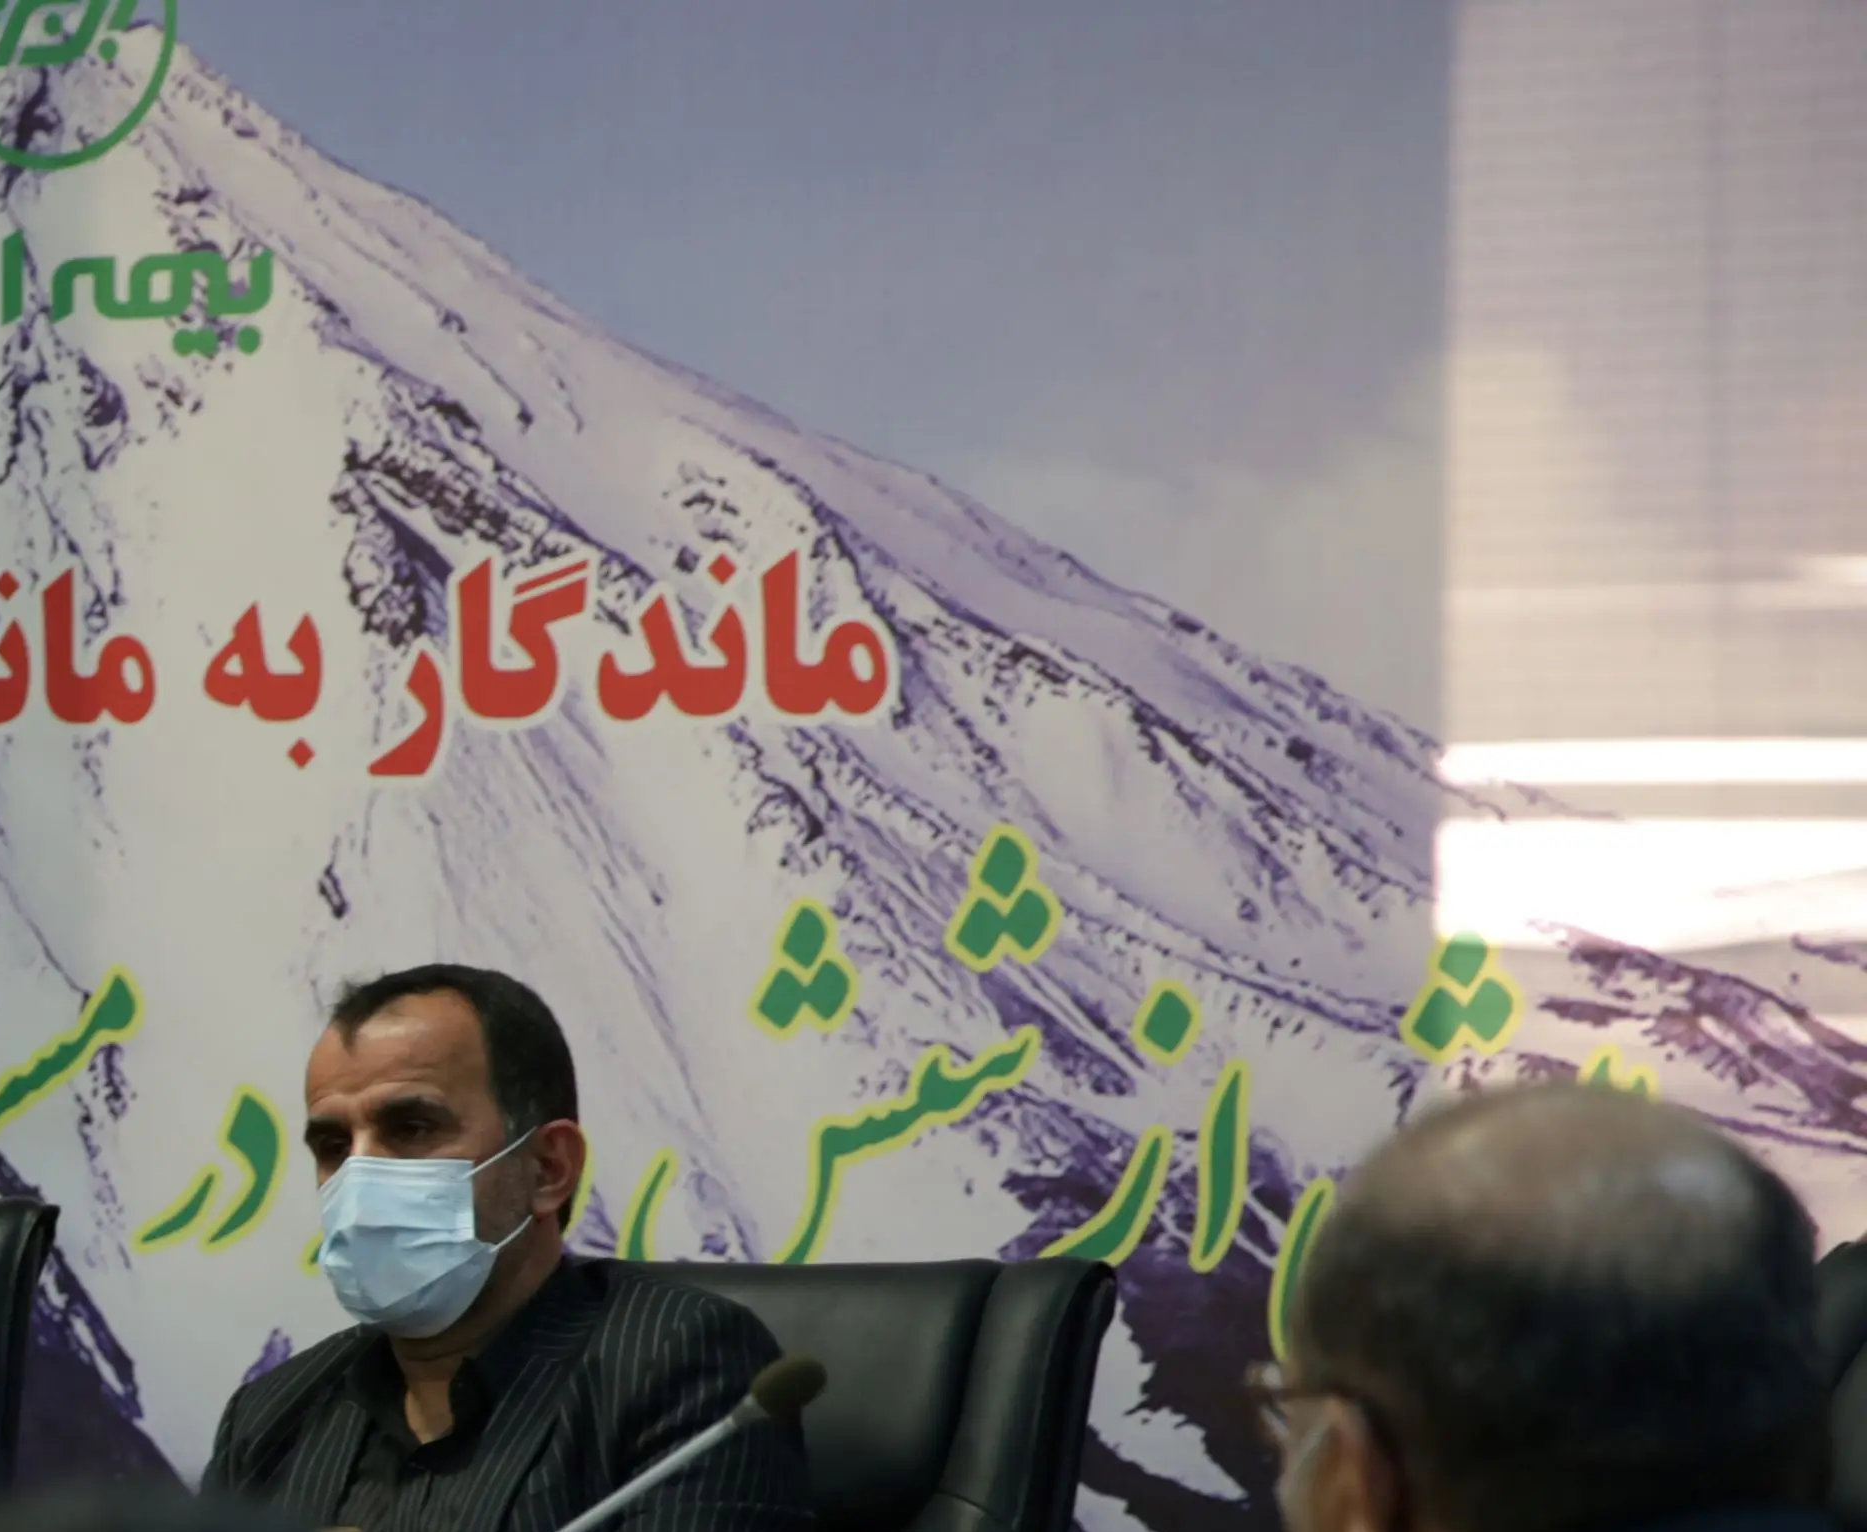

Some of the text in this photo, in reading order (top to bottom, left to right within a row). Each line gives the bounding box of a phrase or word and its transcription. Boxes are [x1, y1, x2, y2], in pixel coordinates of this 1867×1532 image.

[50, 248, 274, 356] بیمه
[203, 605, 323, 769] به
[367, 552, 889, 777] ماندگار
[133, 1085, 287, 1252] در
[1042, 980, 1250, 1273] از
